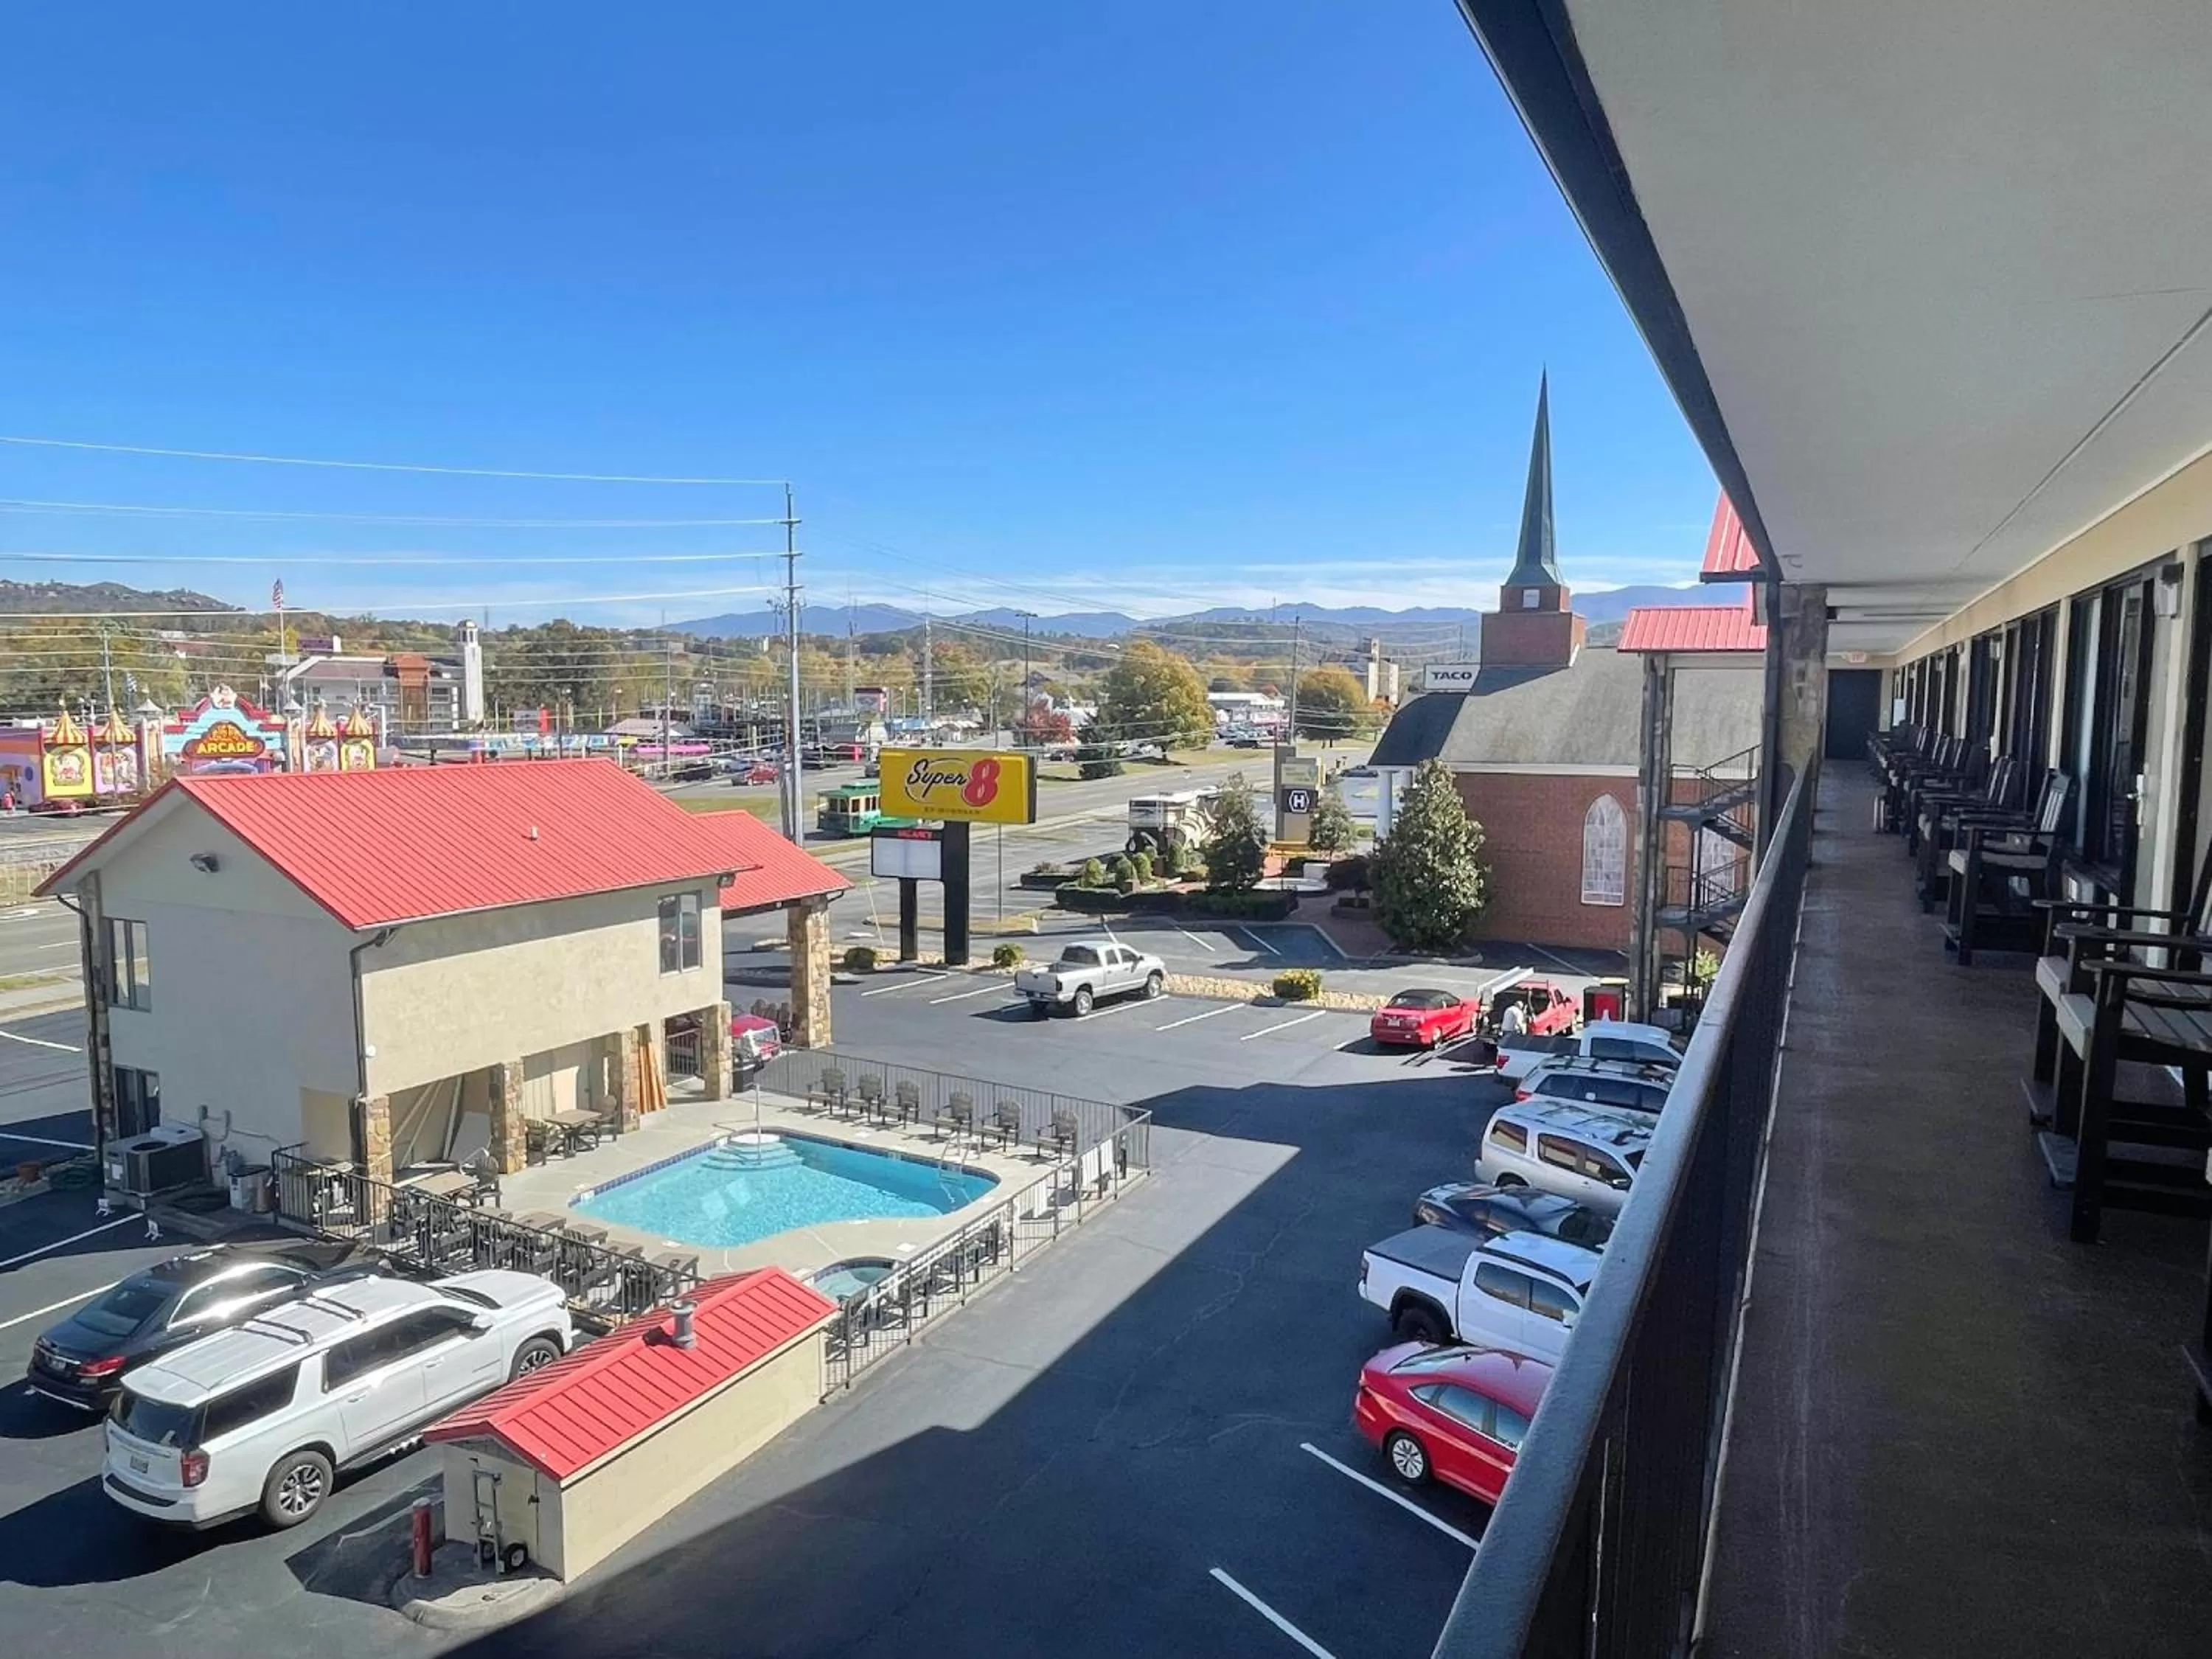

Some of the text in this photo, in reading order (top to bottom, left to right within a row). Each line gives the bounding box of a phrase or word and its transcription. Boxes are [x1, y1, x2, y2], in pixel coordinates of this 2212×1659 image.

[1431, 672, 1472, 680] TACO
[197, 741, 255, 754] ARCADE
[906, 758, 1001, 807] Super 8
